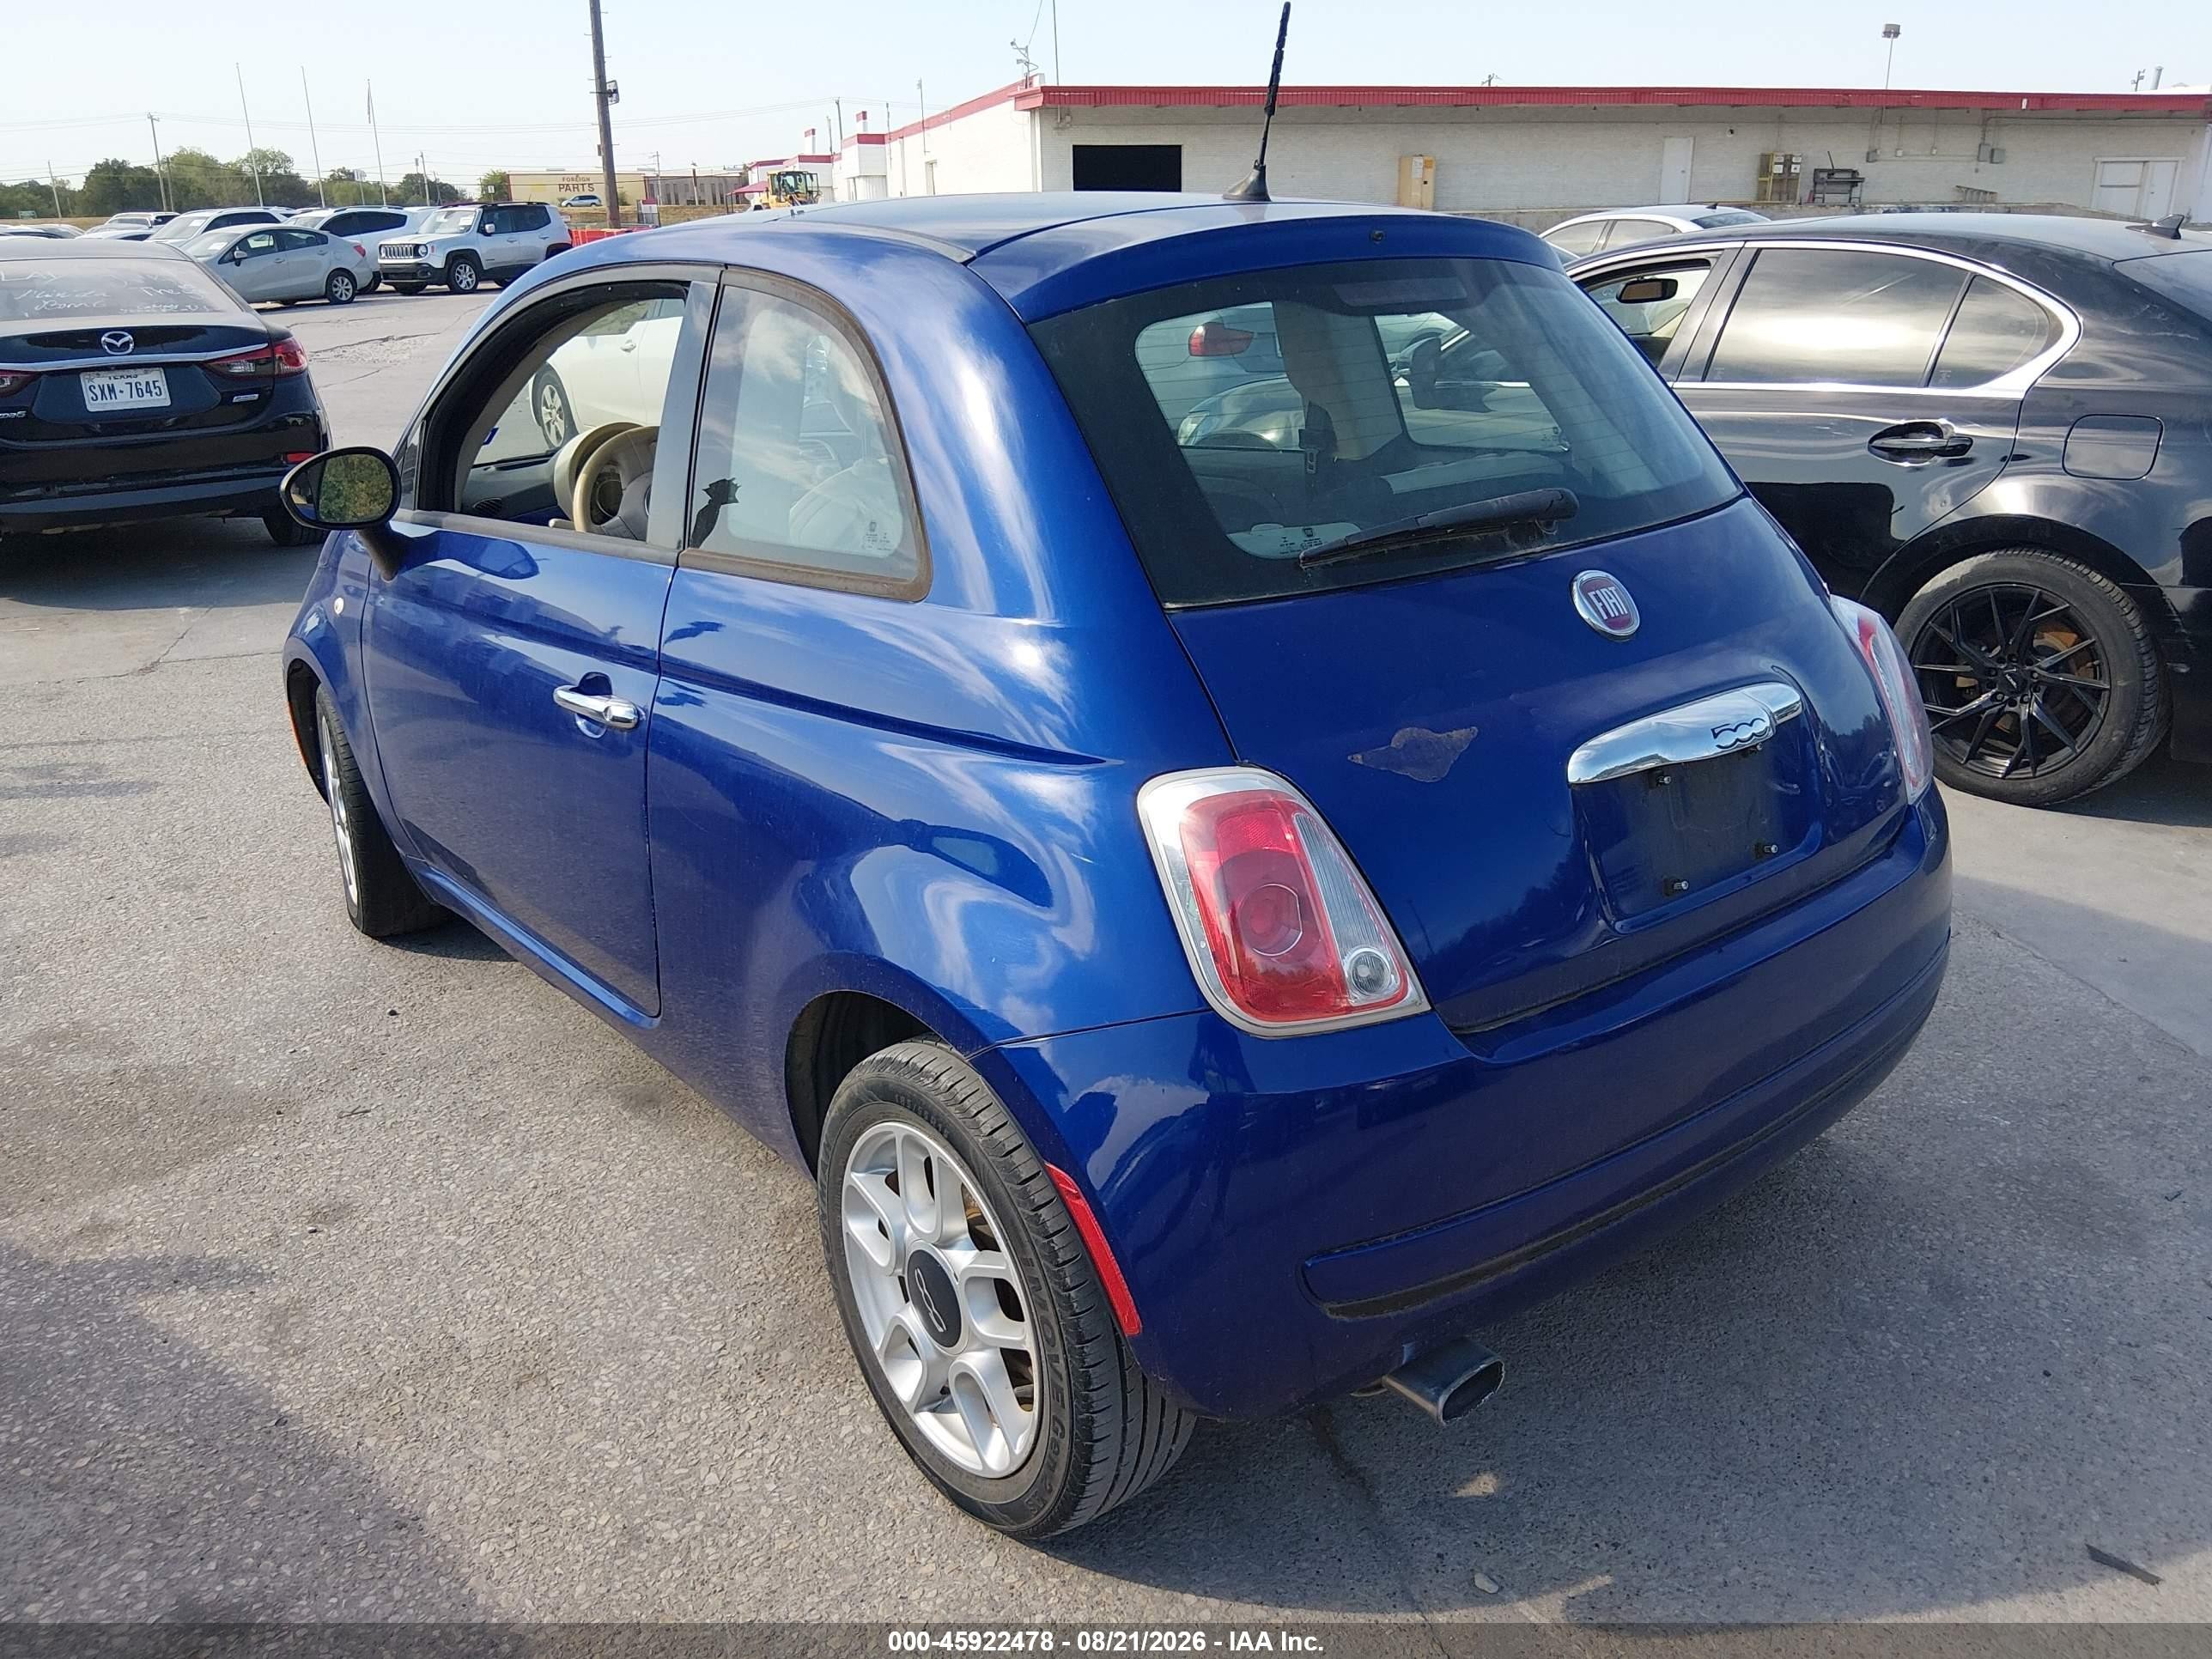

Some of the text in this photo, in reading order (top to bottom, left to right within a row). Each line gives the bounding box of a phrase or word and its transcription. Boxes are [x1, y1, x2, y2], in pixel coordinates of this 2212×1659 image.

[558, 183, 595, 192] PARTS
[1588, 586, 1628, 619] FIAT
[1711, 717, 1769, 749] 500
